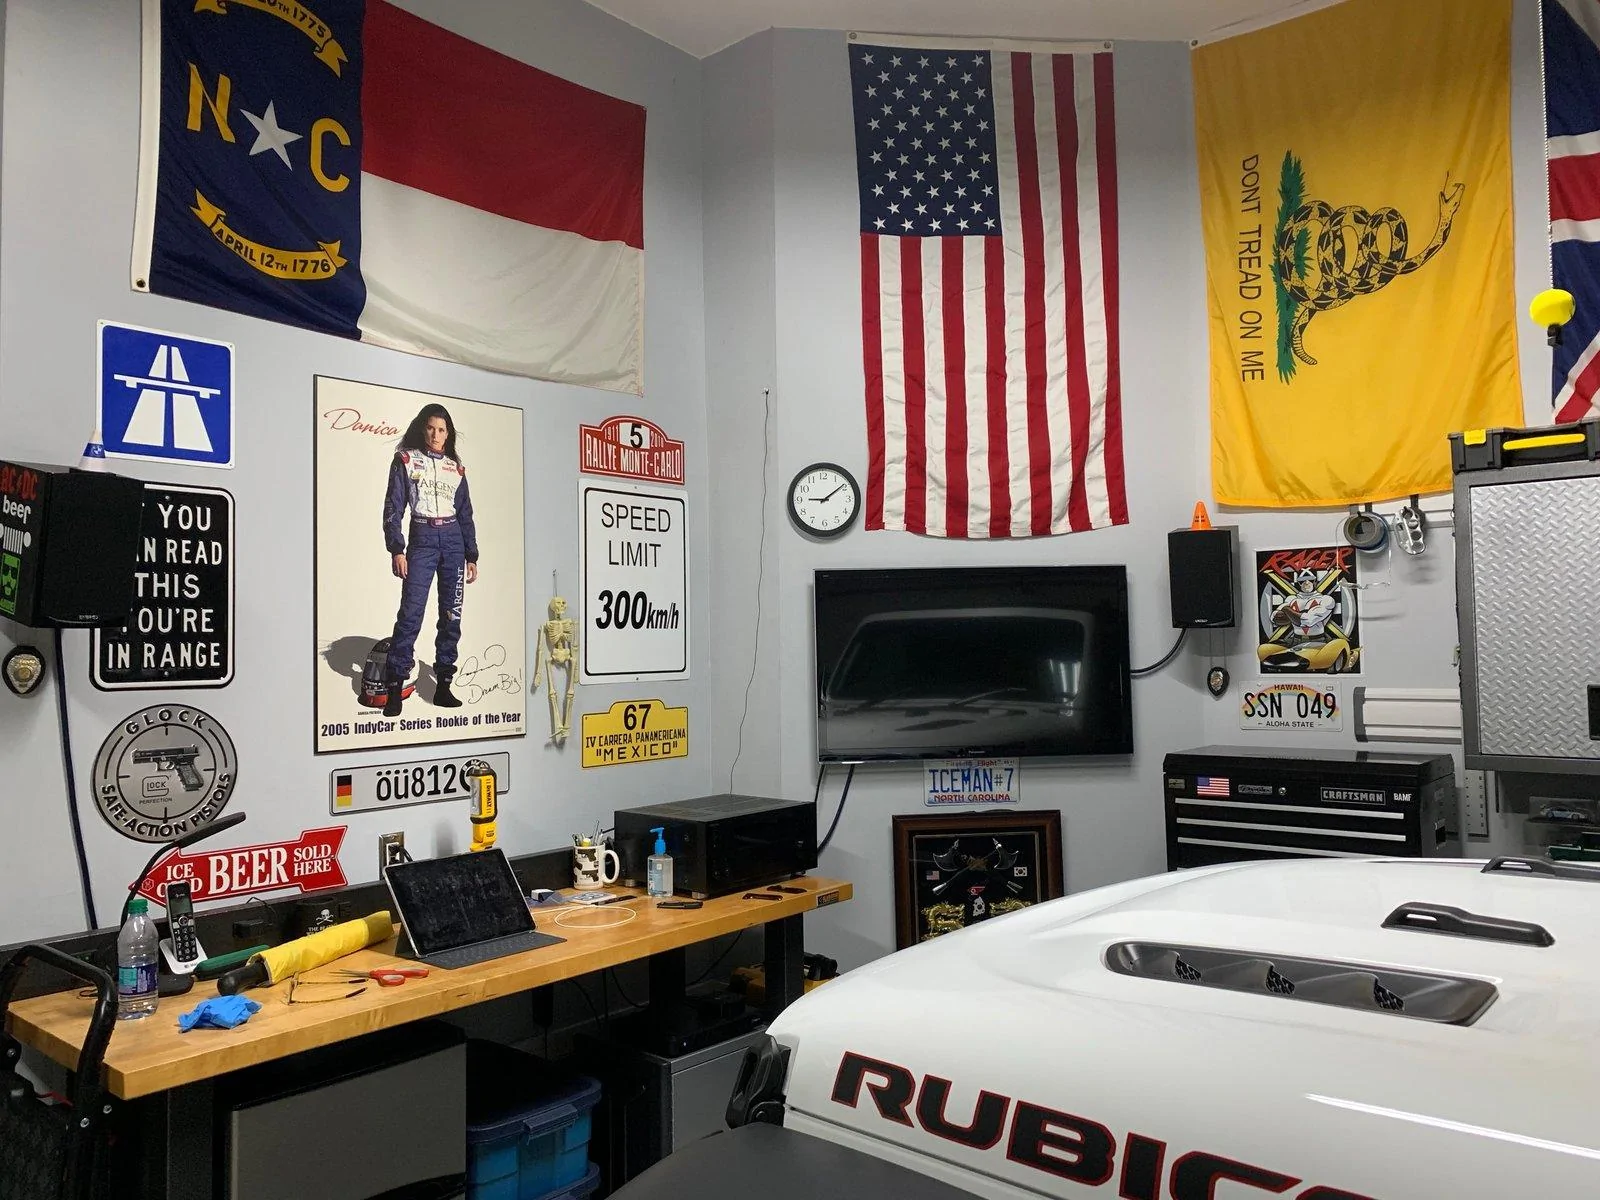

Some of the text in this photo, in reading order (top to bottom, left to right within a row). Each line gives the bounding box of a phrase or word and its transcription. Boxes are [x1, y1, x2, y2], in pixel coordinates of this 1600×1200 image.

[292, 7, 326, 39] 1775
[187, 61, 351, 193] N C
[215, 228, 331, 274] APRIL 12TH 1776
[1239, 154, 1265, 382] DONT TREAD ON ME
[323, 407, 401, 436] Danica
[604, 424, 619, 442] 1911
[630, 422, 643, 448] 5
[585, 433, 681, 479] RALLYE MONTE-CARLO
[157, 503, 211, 531] YOU
[601, 502, 671, 533] SPEED
[166, 538, 223, 565] READ
[608, 540, 661, 568] LIMIT
[134, 572, 200, 599] THIS
[452, 566, 464, 614] ARGENT
[122, 607, 214, 633] OU'RE
[107, 641, 221, 669] IN RANGE
[623, 703, 652, 731] 67
[1244, 692, 1336, 718] SSN 049
[125, 709, 206, 735] GLOCK
[321, 712, 521, 737] 2005 IndyCar Series Rookie of the Year
[586, 728, 686, 748] IV CARRERA PANAMERICANA
[101, 772, 231, 837] SAFE-ACTION PISTOLS
[934, 793, 1011, 802] NORTH CAROLINA
[1323, 790, 1383, 802] CRAFTSMAN
[1393, 792, 1412, 802] BAMF
[293, 844, 333, 862] SOLD
[166, 862, 195, 881] ICE
[207, 847, 290, 895] BEER
[293, 859, 332, 877] HERE
[156, 877, 203, 898] CD
[831, 1051, 1380, 1200] RUBIC
